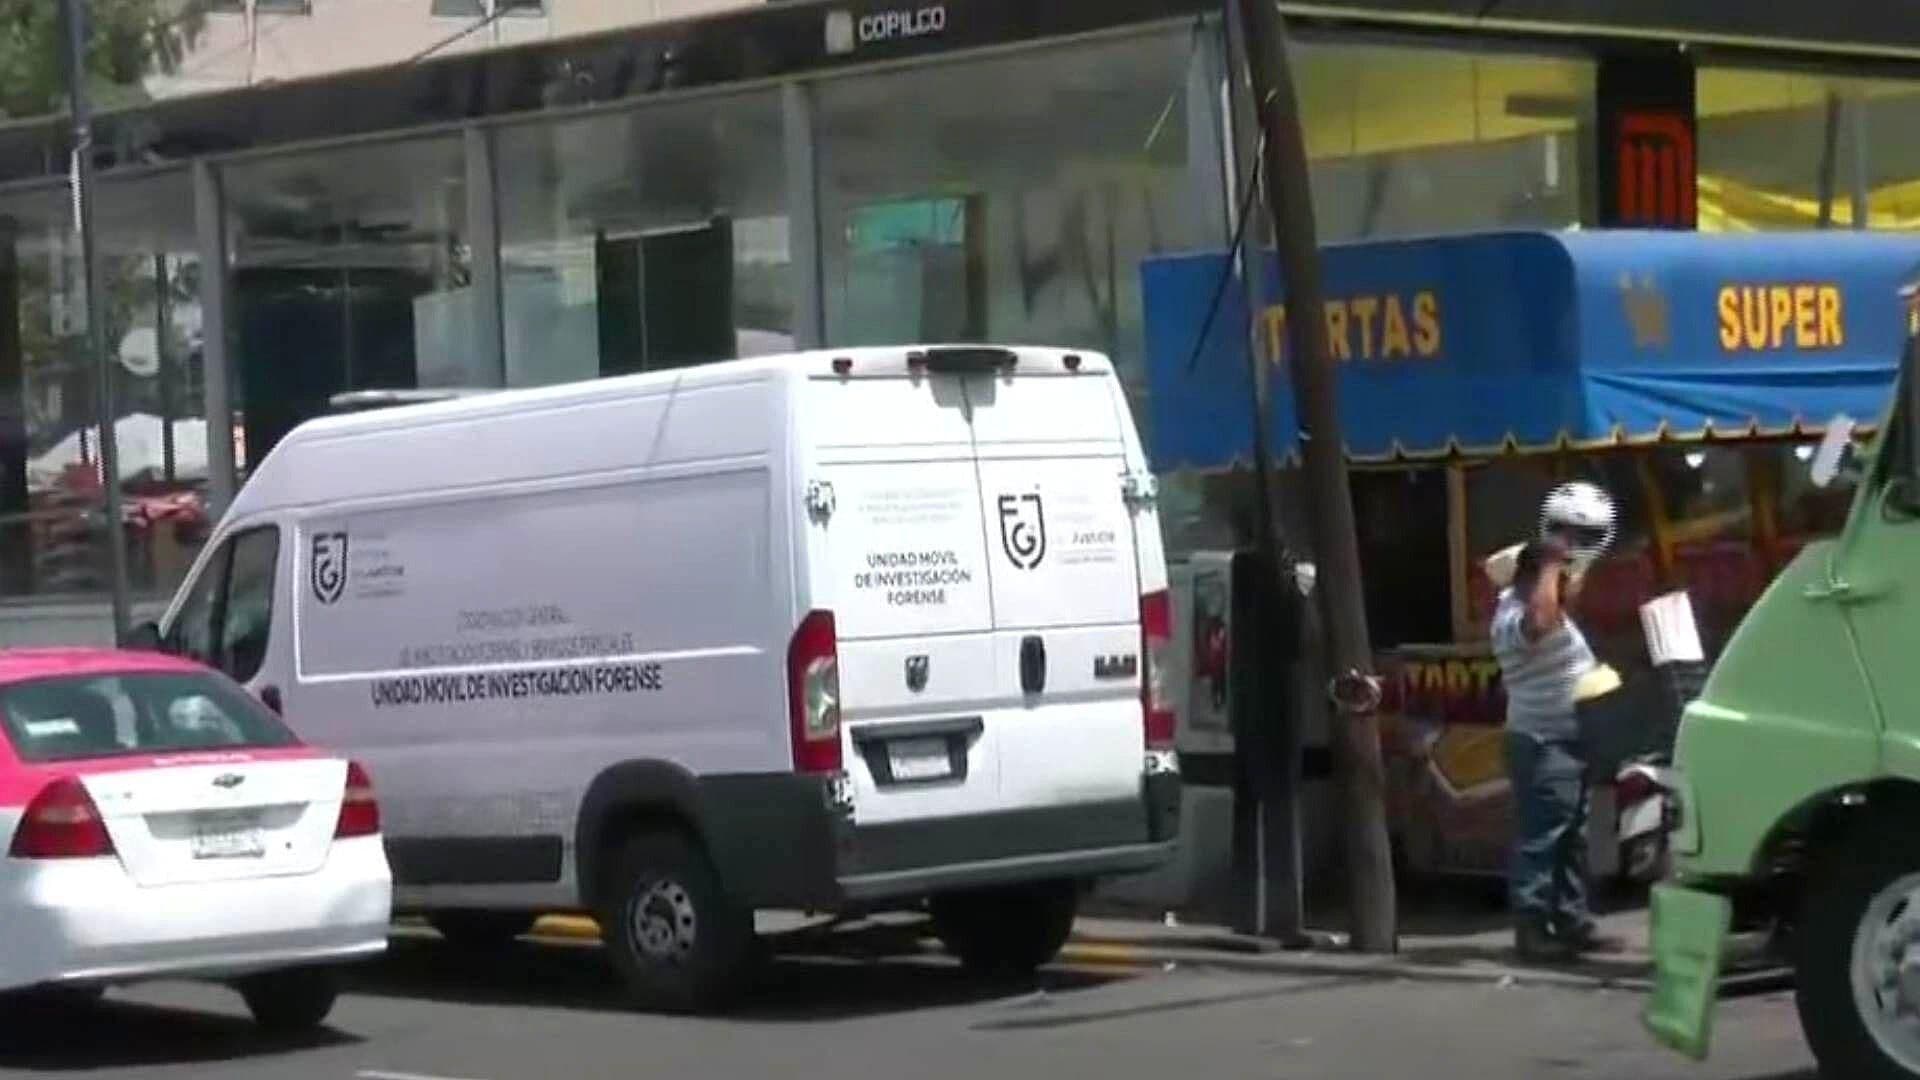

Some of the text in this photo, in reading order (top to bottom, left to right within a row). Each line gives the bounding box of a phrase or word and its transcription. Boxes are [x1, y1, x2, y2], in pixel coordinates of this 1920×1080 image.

[859, 6, 945, 41] COPILCO
[1252, 291, 1440, 363] TRTAS
[1716, 284, 1844, 350] SUPER
[854, 571, 873, 588] DE
[886, 588, 946, 606] FORENSE
[370, 677, 421, 706] UNIDAD
[466, 672, 487, 699] DE
[595, 662, 663, 693] FORENSE
